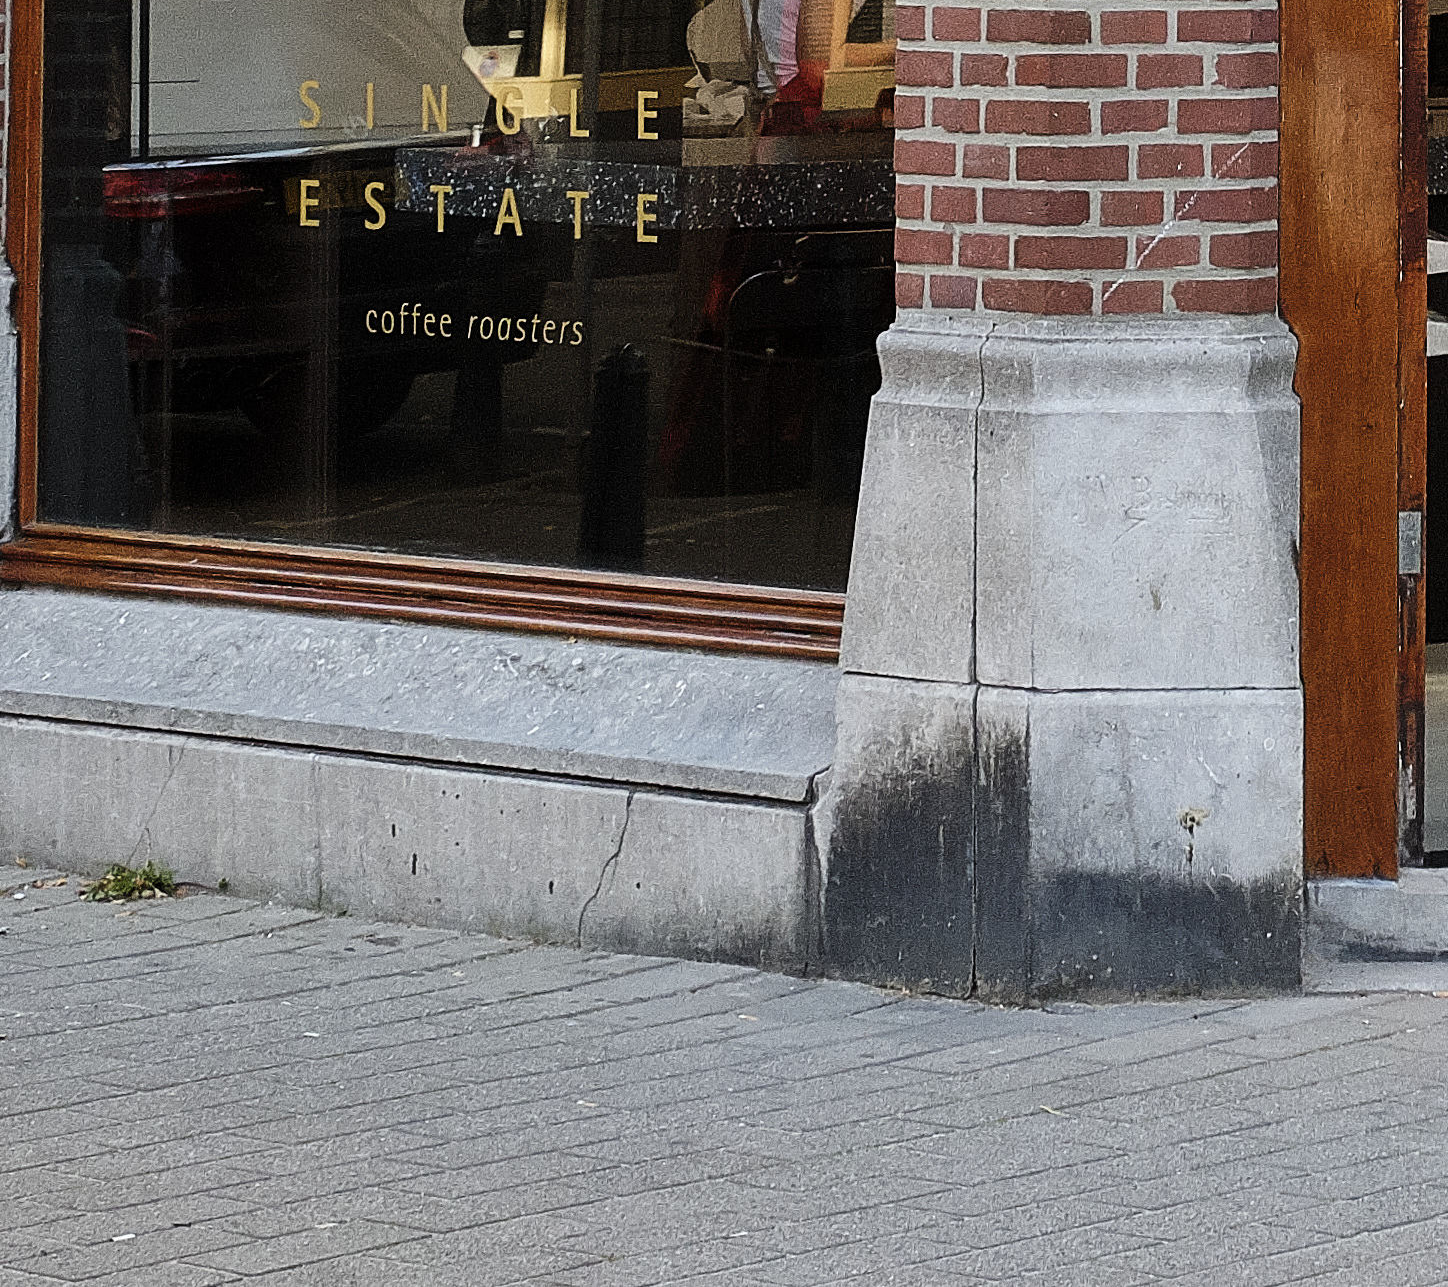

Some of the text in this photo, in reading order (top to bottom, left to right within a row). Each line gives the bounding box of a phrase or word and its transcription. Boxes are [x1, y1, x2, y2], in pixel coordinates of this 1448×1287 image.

[299, 79, 659, 140] SINGLE
[299, 179, 659, 243] ESTATE
[365, 302, 584, 346] coffee roasters
